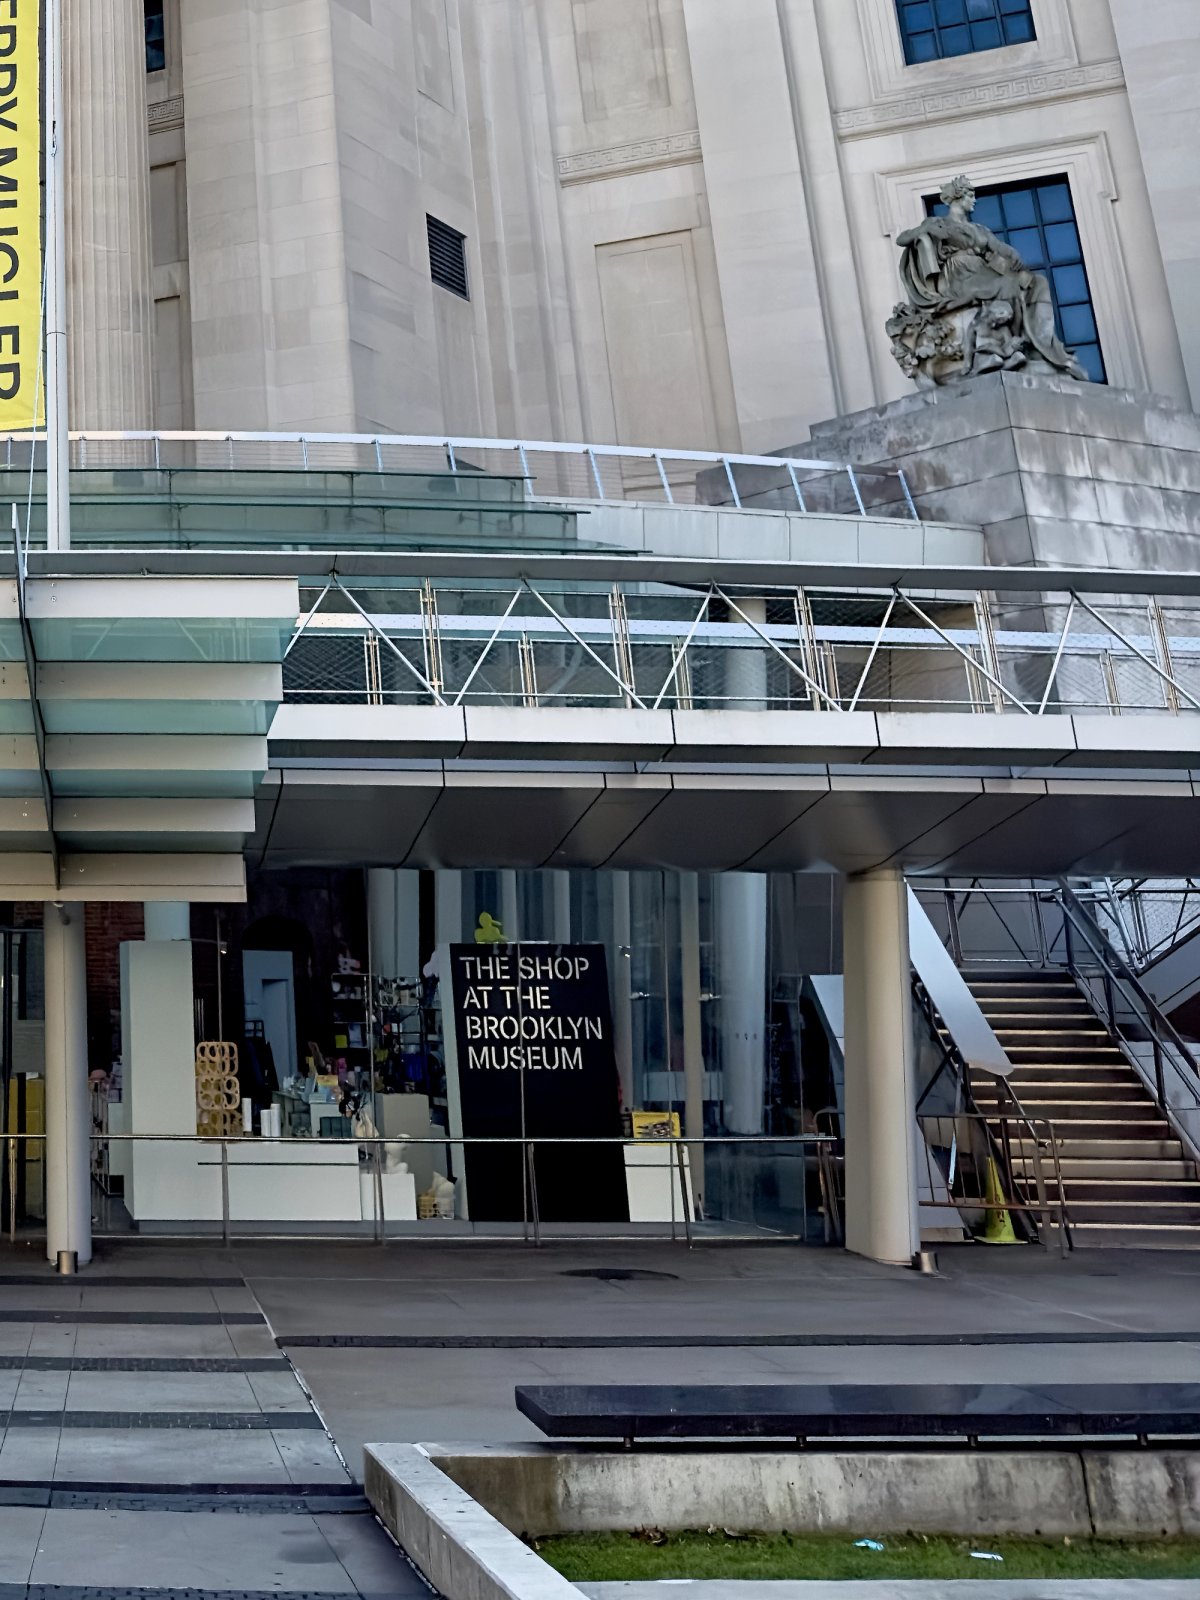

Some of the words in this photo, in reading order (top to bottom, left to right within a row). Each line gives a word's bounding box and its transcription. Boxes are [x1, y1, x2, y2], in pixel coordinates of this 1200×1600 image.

[458, 956, 511, 980] THE
[518, 956, 590, 980] SHOP
[462, 985, 493, 1009] AT
[499, 985, 552, 1010] THE
[465, 1015, 603, 1040] BROOKLYN
[467, 1045, 583, 1070] MUSEUM
